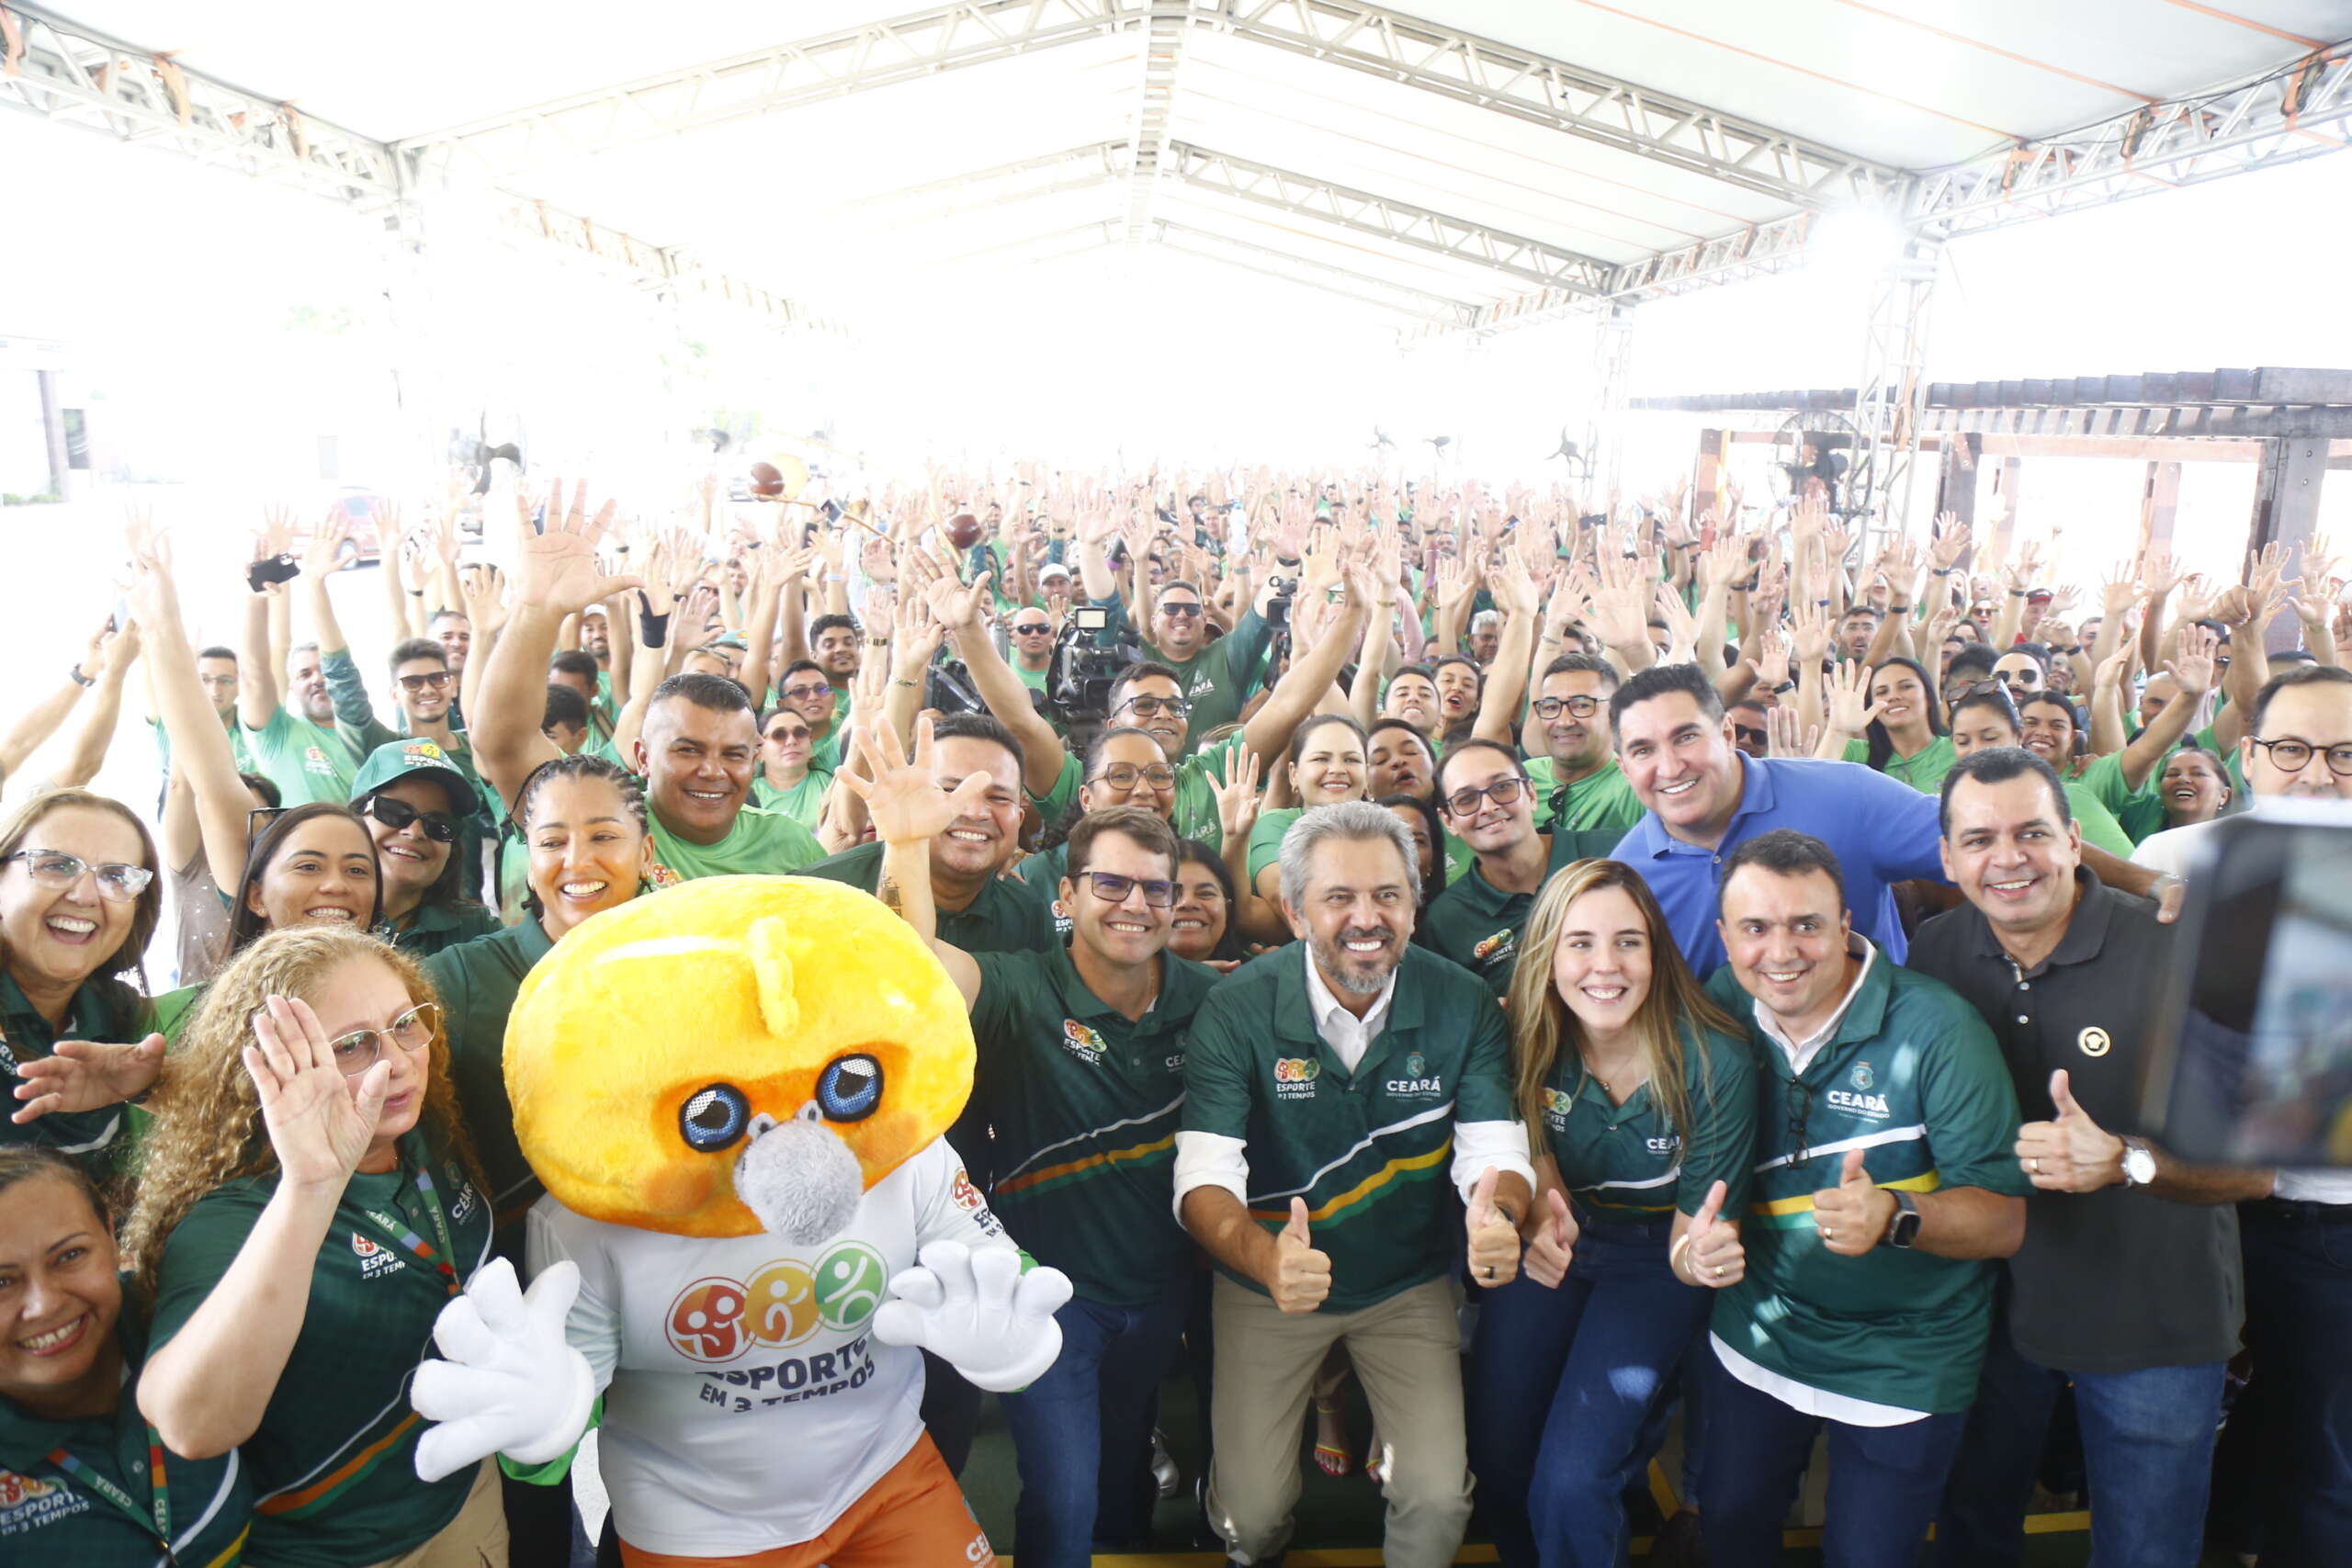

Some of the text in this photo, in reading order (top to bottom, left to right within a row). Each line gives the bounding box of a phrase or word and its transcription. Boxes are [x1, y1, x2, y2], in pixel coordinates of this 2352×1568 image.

[1277, 1081, 1316, 1092] ESPORTE
[1386, 1076, 1441, 1092] CEARÁ
[1828, 1090, 1890, 1112] CEARÁ
[699, 1353, 875, 1413] EM 3 TEMPOS
[33, 1501, 90, 1529] TEMPOS
